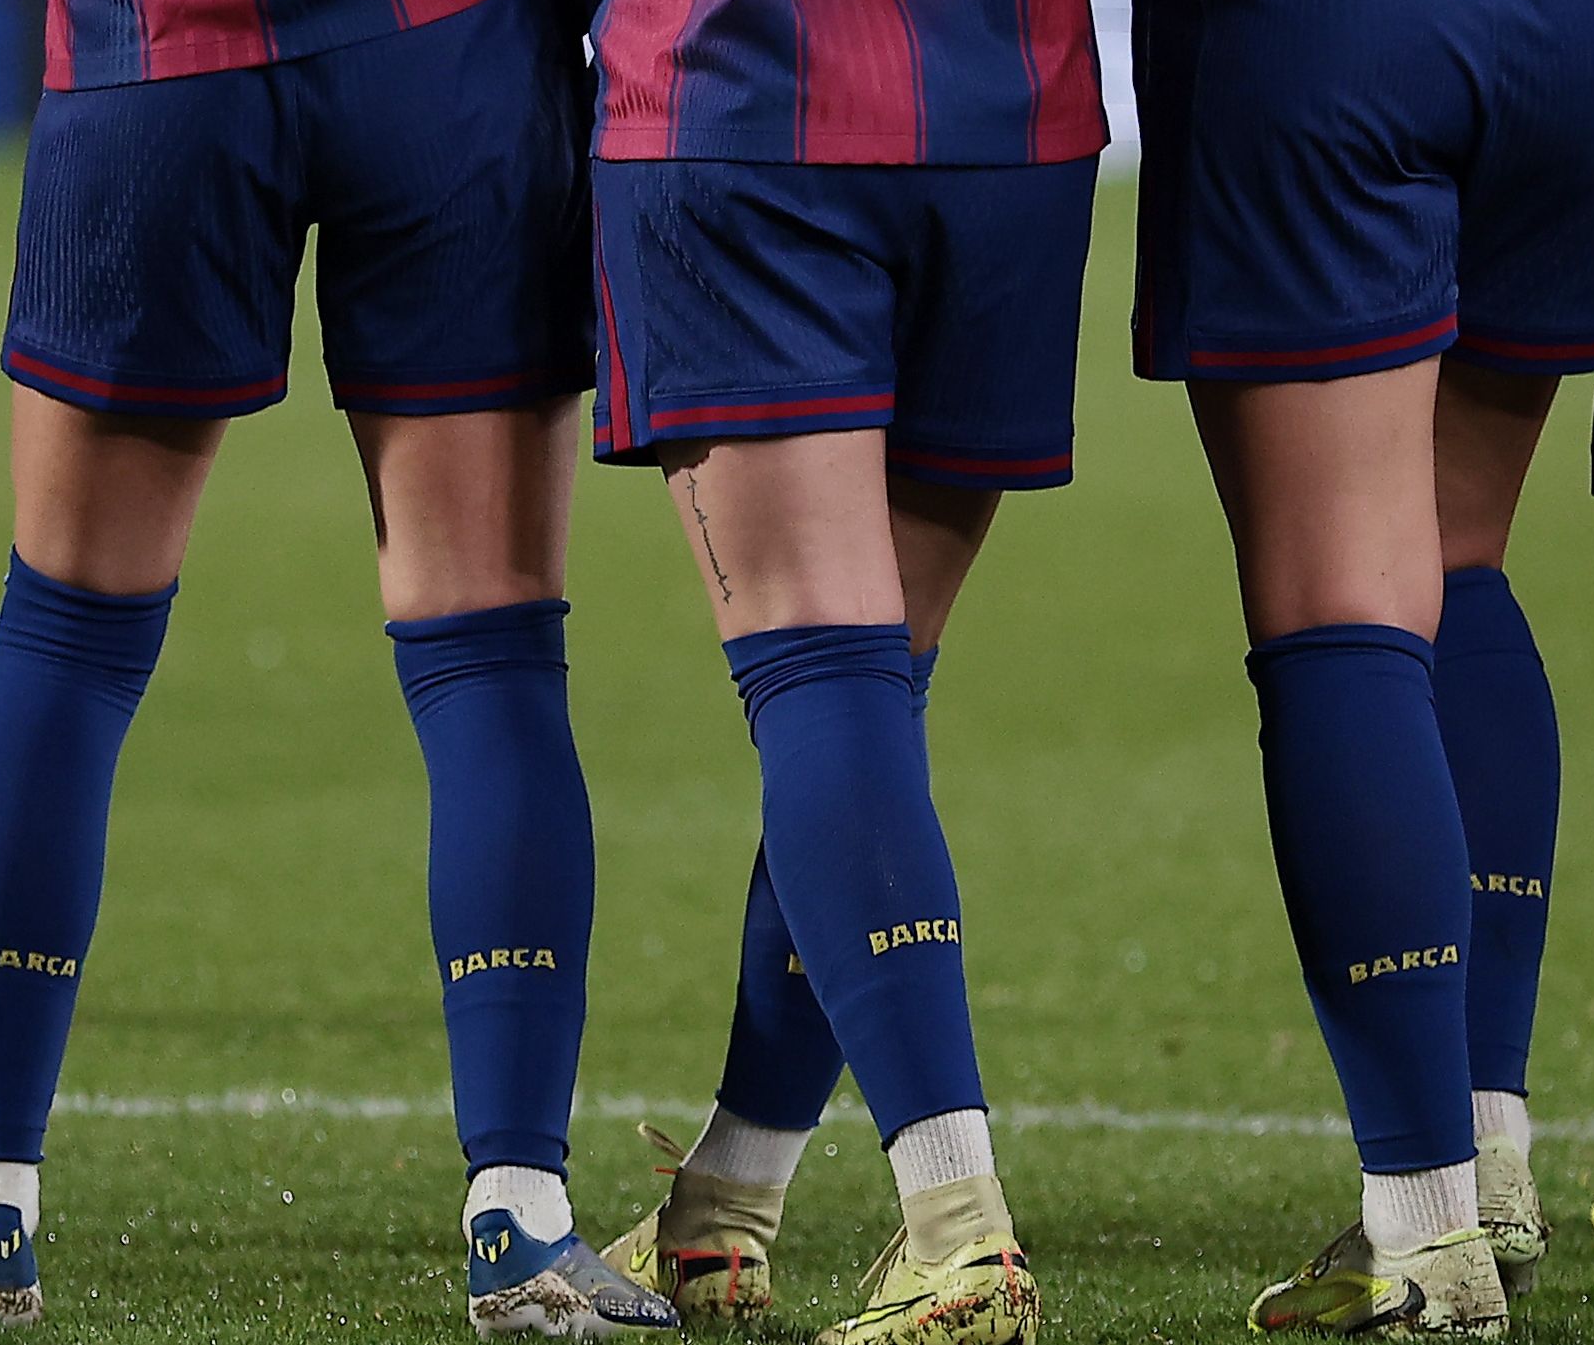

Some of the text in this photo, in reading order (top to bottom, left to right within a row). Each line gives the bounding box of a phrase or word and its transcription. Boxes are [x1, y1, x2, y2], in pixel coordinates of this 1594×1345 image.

[1469, 872, 1544, 899] ARÇA
[868, 918, 960, 956] BARÇA
[449, 947, 556, 982] BARÇA
